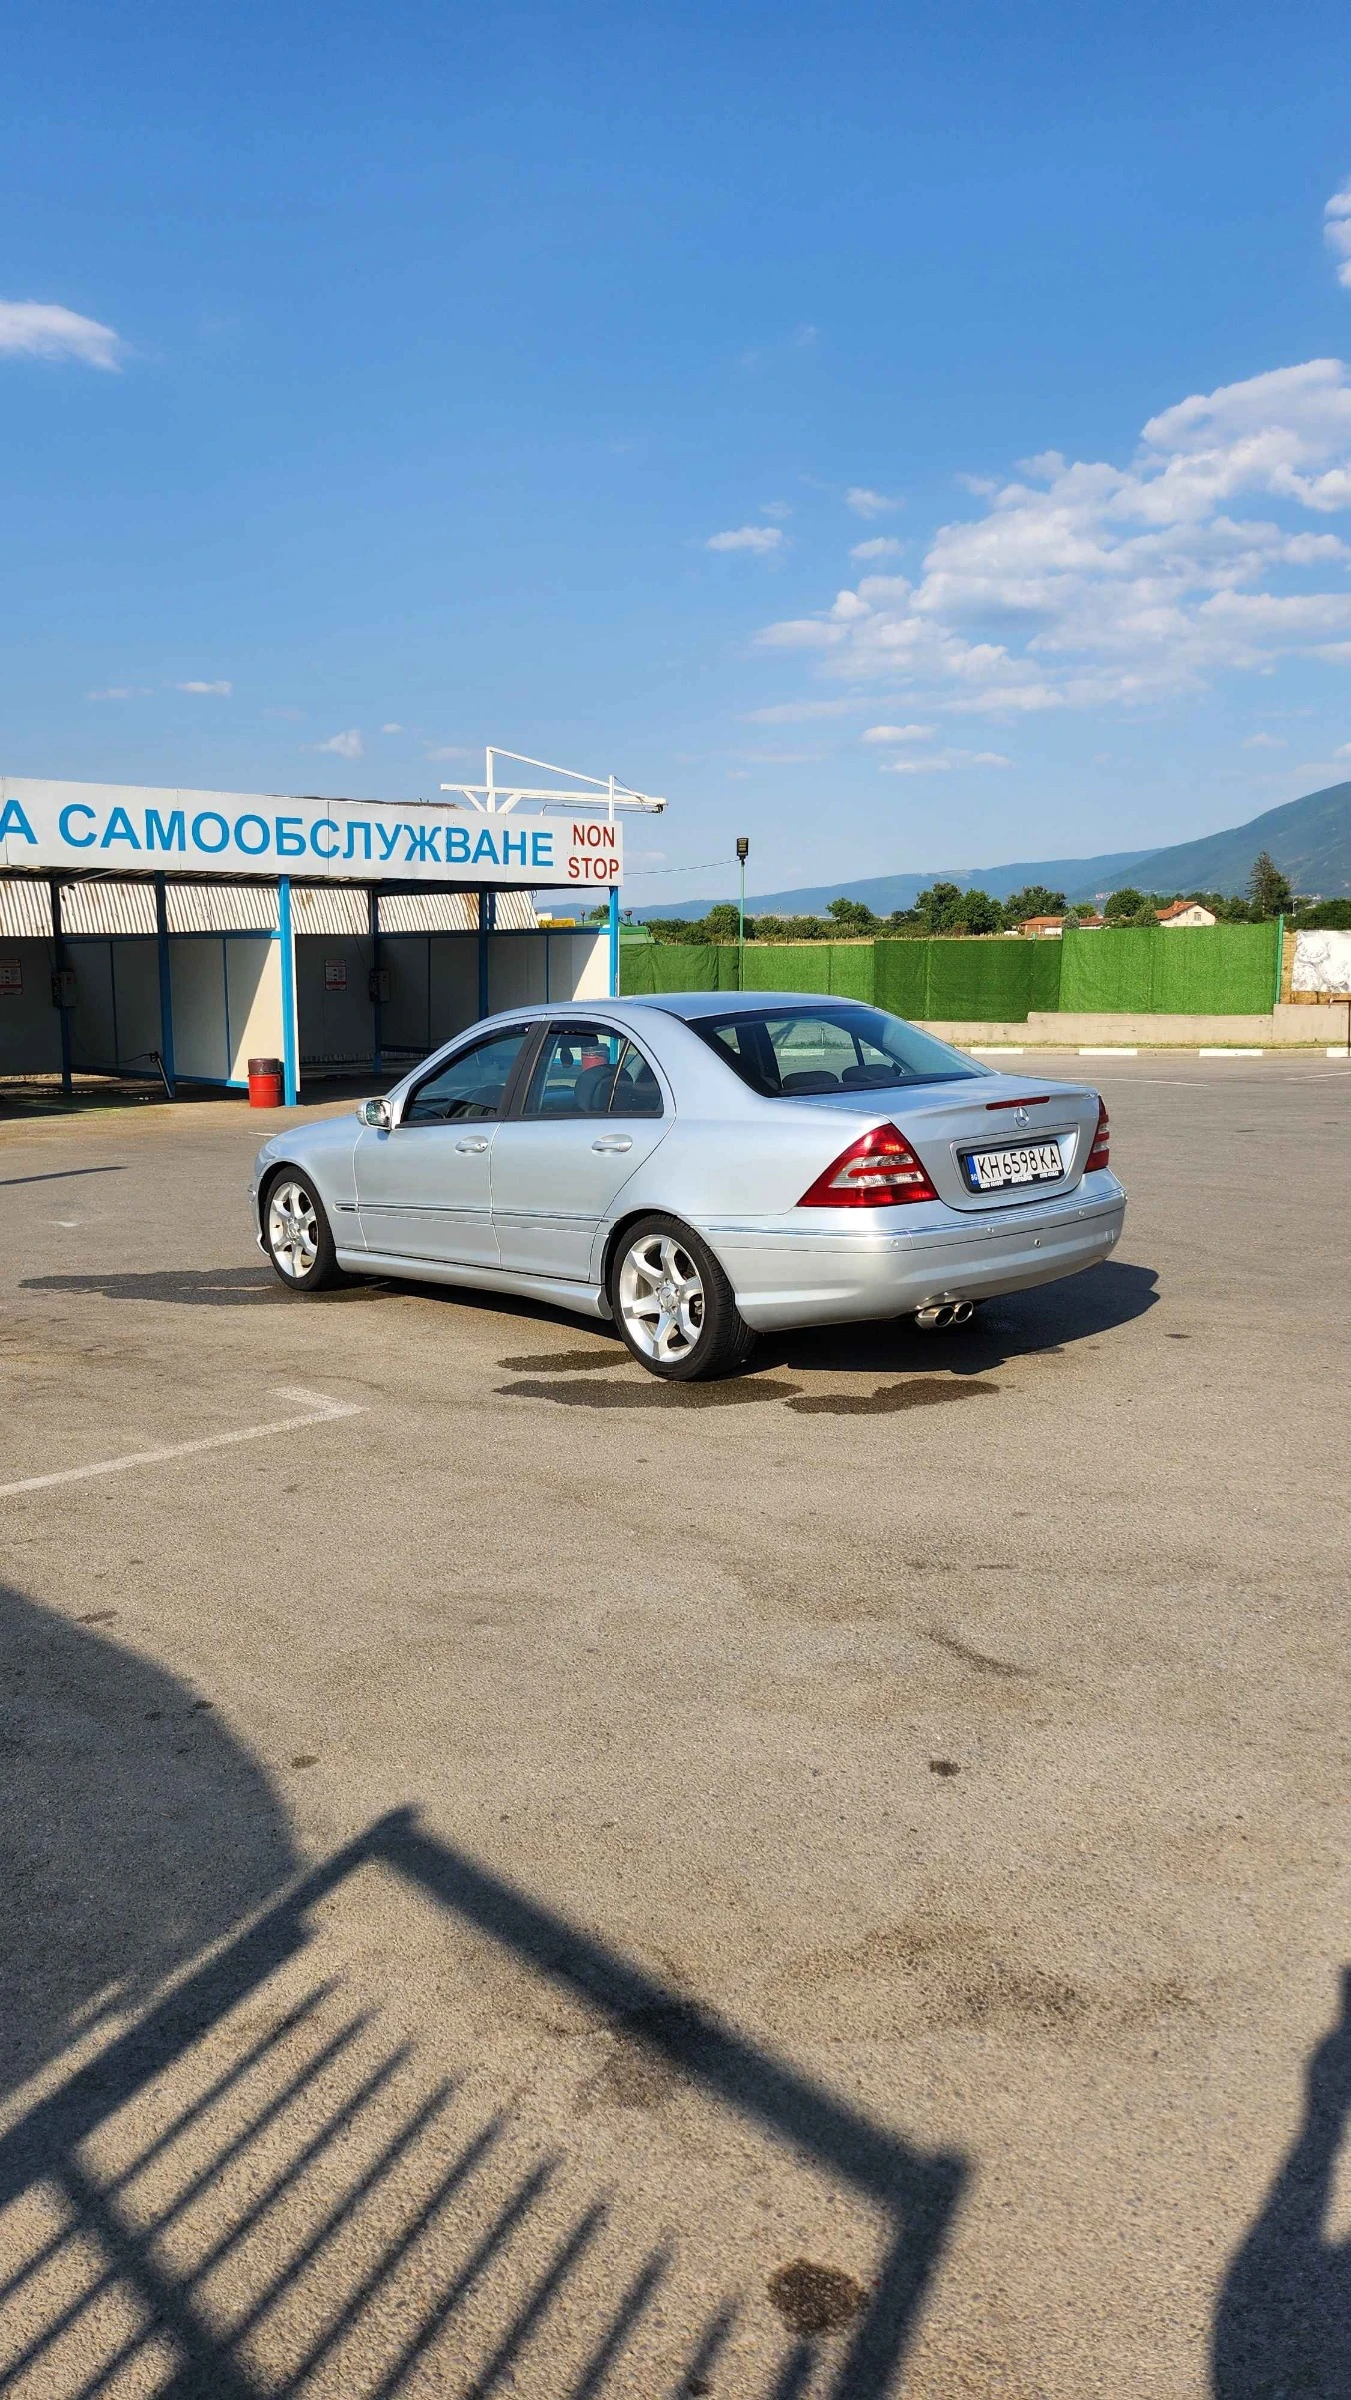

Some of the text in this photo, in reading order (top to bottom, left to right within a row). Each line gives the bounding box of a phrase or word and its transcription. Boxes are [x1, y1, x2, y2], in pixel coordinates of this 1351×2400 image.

[58, 803, 554, 867] САМООБСЛУЖВАНЕ
[573, 824, 615, 848] NON
[567, 856, 620, 880] STOP
